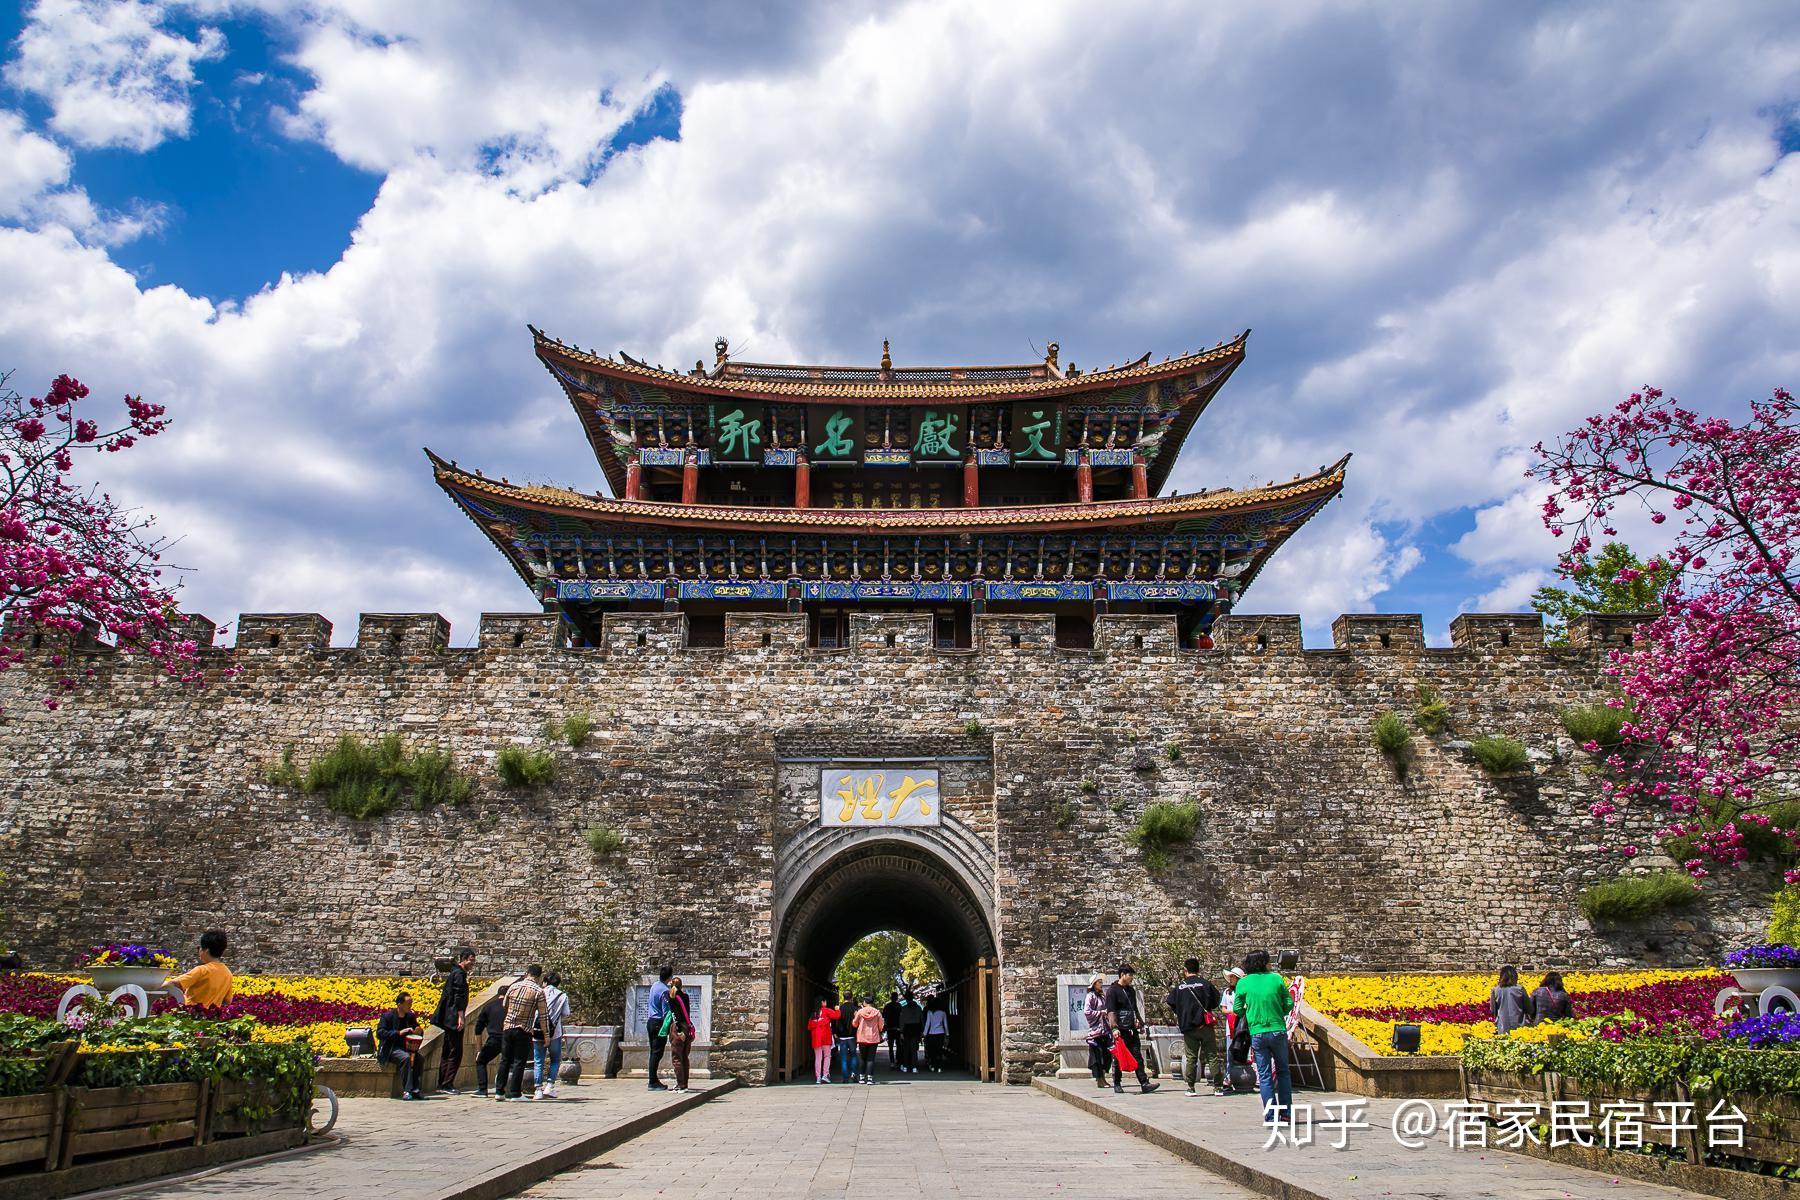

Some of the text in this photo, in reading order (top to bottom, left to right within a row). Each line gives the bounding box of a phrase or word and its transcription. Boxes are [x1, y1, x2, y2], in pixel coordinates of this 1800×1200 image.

[814, 409, 854, 457] 名
[1014, 410, 1057, 459] 文
[837, 773, 936, 823] 大理
